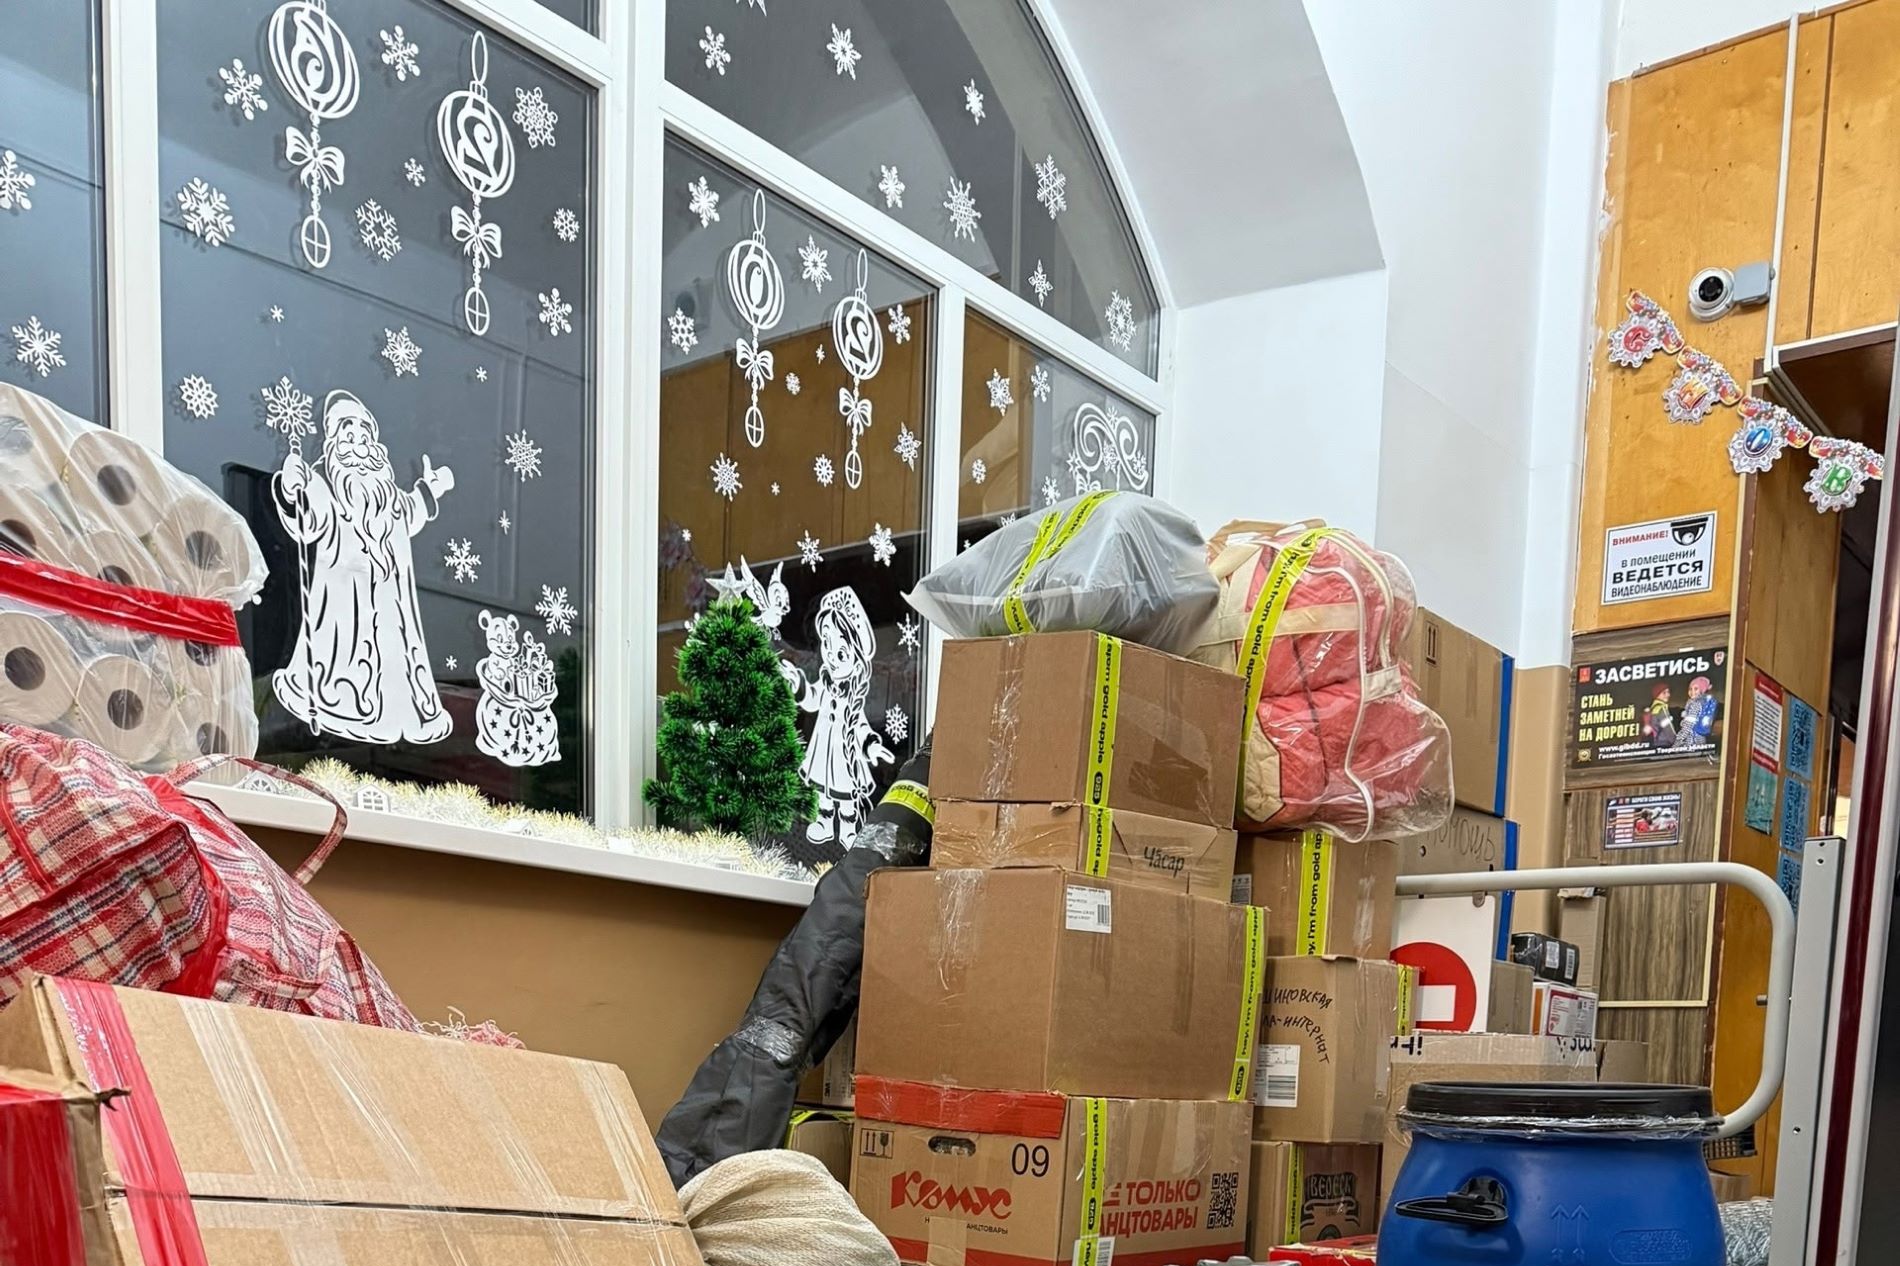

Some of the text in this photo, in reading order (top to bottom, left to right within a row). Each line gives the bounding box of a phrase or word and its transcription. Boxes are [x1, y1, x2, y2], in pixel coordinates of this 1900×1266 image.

[1612, 530, 1669, 546] ВНИМАНИЕ!
[1612, 560, 1704, 584] ВЕДЕТСЯ
[1621, 549, 1696, 568] в помещении
[1611, 575, 1703, 598] ВИДЕОНАБЛЮДЕНИЕ
[1253, 624, 1264, 656] gold
[1595, 656, 1710, 685] ЗАСВЕТИСЬ
[1101, 685, 1110, 719] gold
[1580, 704, 1636, 725] ЗАМЕТНЕЙ
[1581, 693, 1614, 709] СТАНЬ
[1097, 722, 1109, 764] apple
[1579, 723, 1640, 742] НА ДОРОГЕ!
[1312, 852, 1321, 882] gold
[1309, 884, 1318, 917] from
[1011, 1142, 1050, 1178] 09
[890, 1170, 1012, 1220] Комус
[1126, 1178, 1202, 1206] ТОЛЬКО
